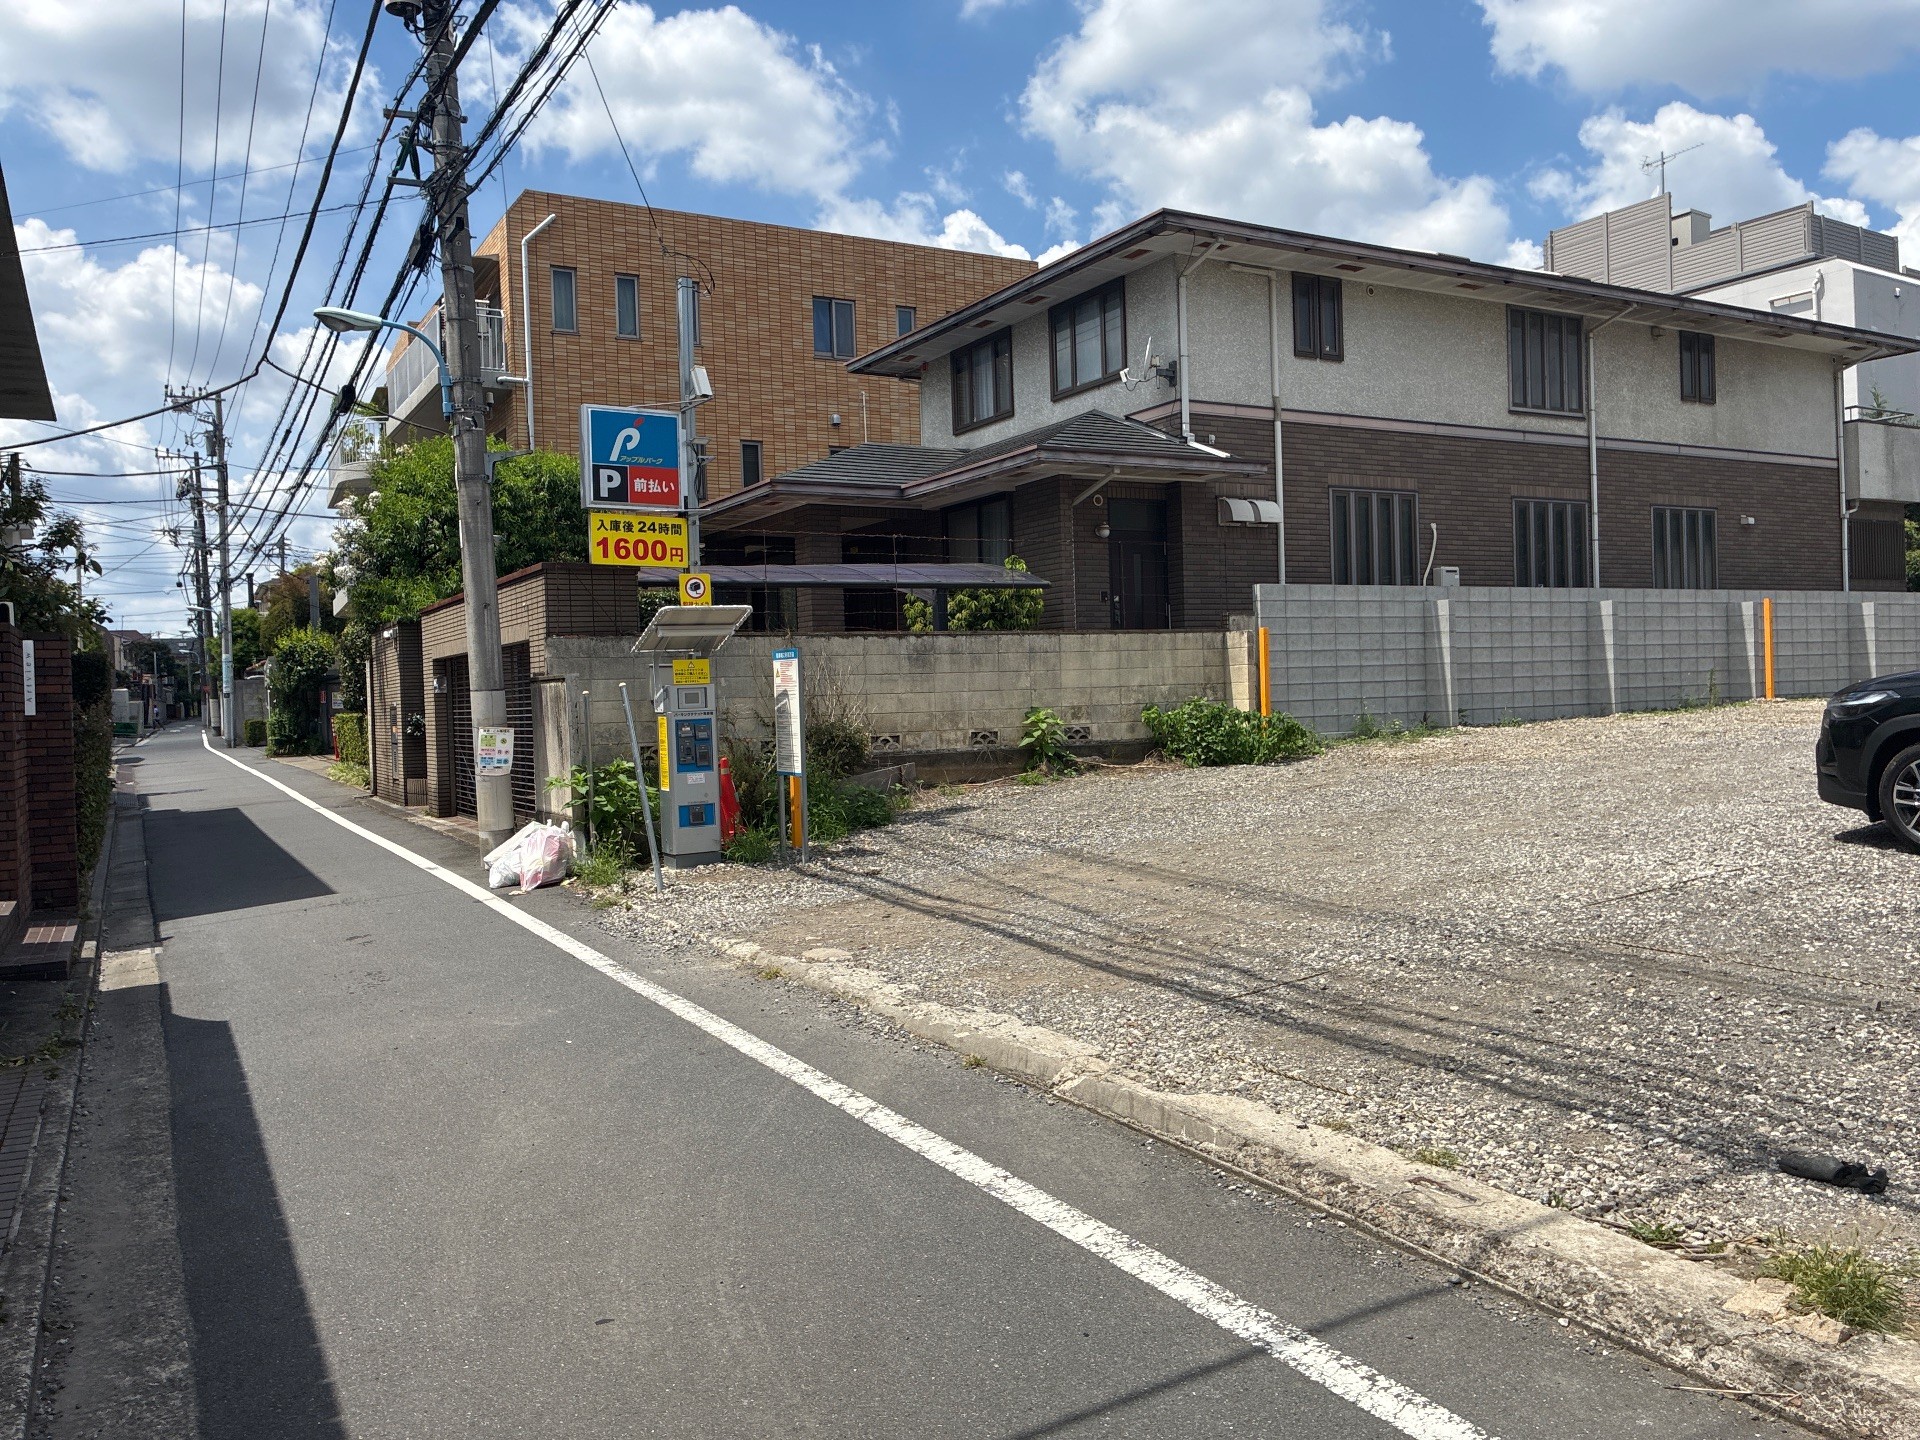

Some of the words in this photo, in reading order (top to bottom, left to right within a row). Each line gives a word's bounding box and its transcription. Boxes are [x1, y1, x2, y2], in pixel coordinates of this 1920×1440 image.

[620, 455, 663, 465] アップルパーク
[599, 468, 621, 498] P
[634, 477, 675, 493] 前払い
[596, 519, 682, 536] 入庫後24時間
[596, 536, 684, 563] 1600円
